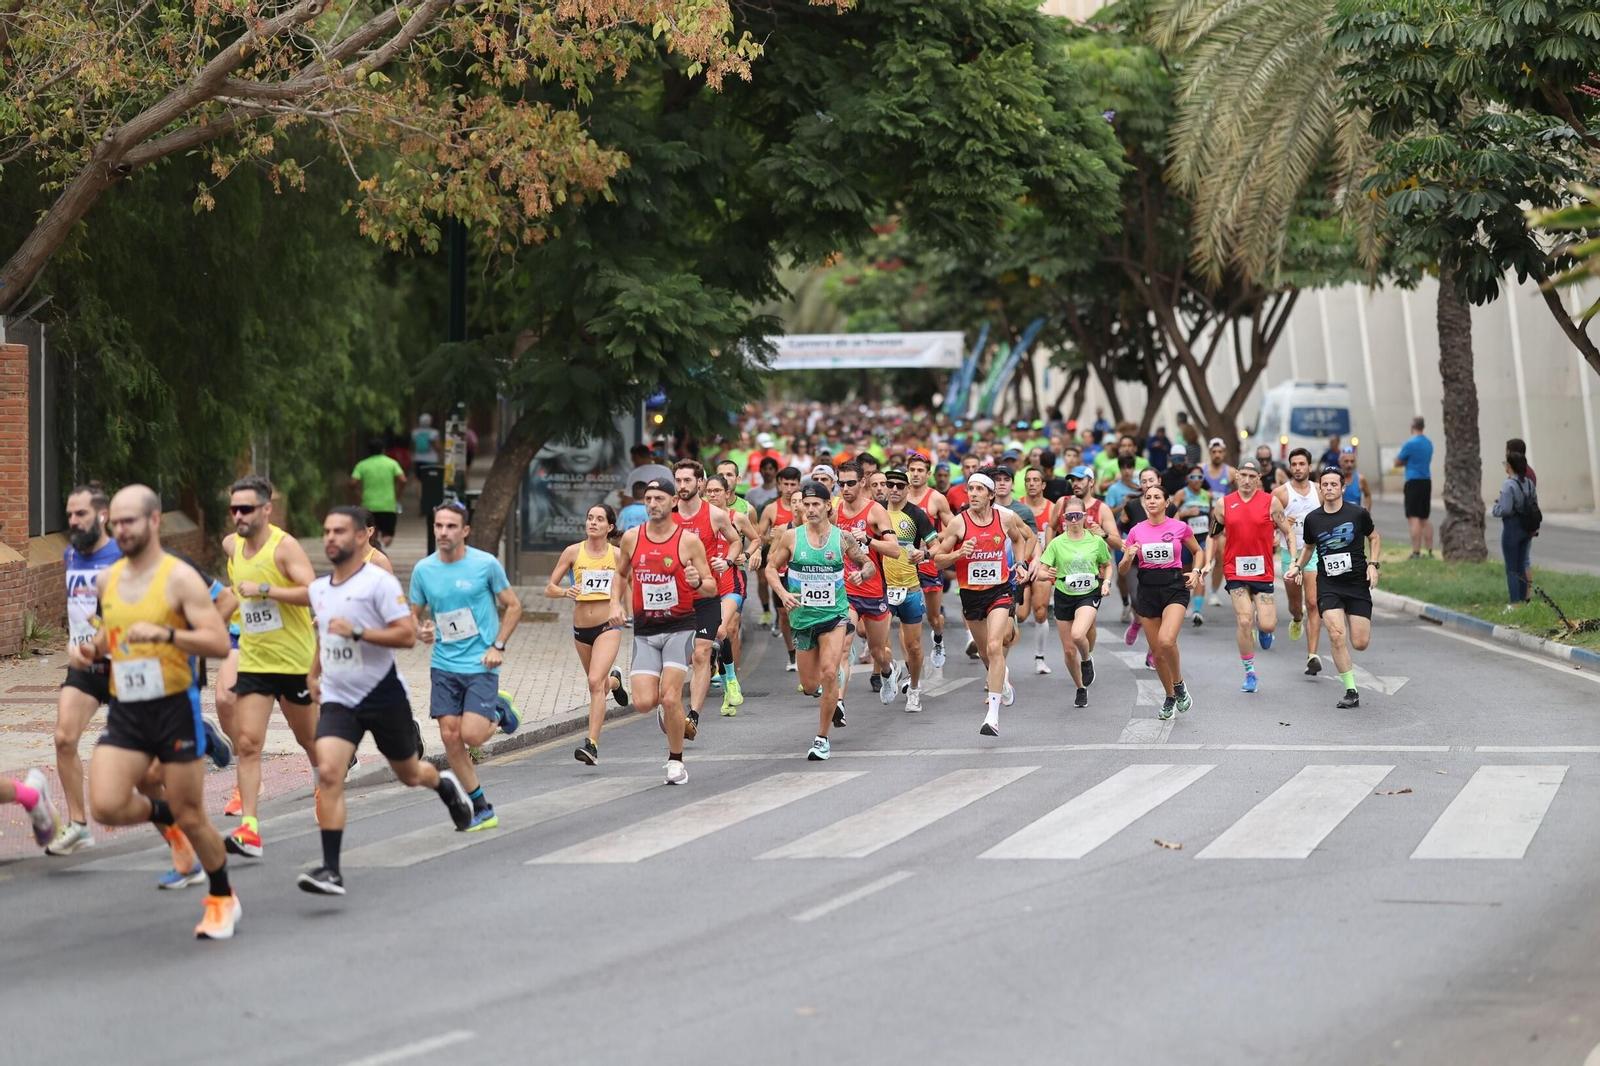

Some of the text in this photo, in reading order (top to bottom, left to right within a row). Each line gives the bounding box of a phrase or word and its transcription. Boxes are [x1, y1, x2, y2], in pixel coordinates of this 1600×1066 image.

[1146, 550, 1169, 559] 538
[1243, 563, 1257, 571] 90
[1327, 560, 1346, 570] 931
[972, 569, 996, 578] 624
[586, 578, 609, 588] 477
[1069, 579, 1091, 588] 478
[647, 591, 673, 603] 732
[806, 590, 830, 600] 403
[245, 609, 272, 624] 885
[449, 621, 458, 632] 1
[326, 647, 353, 661] 790
[124, 673, 146, 689] 33
